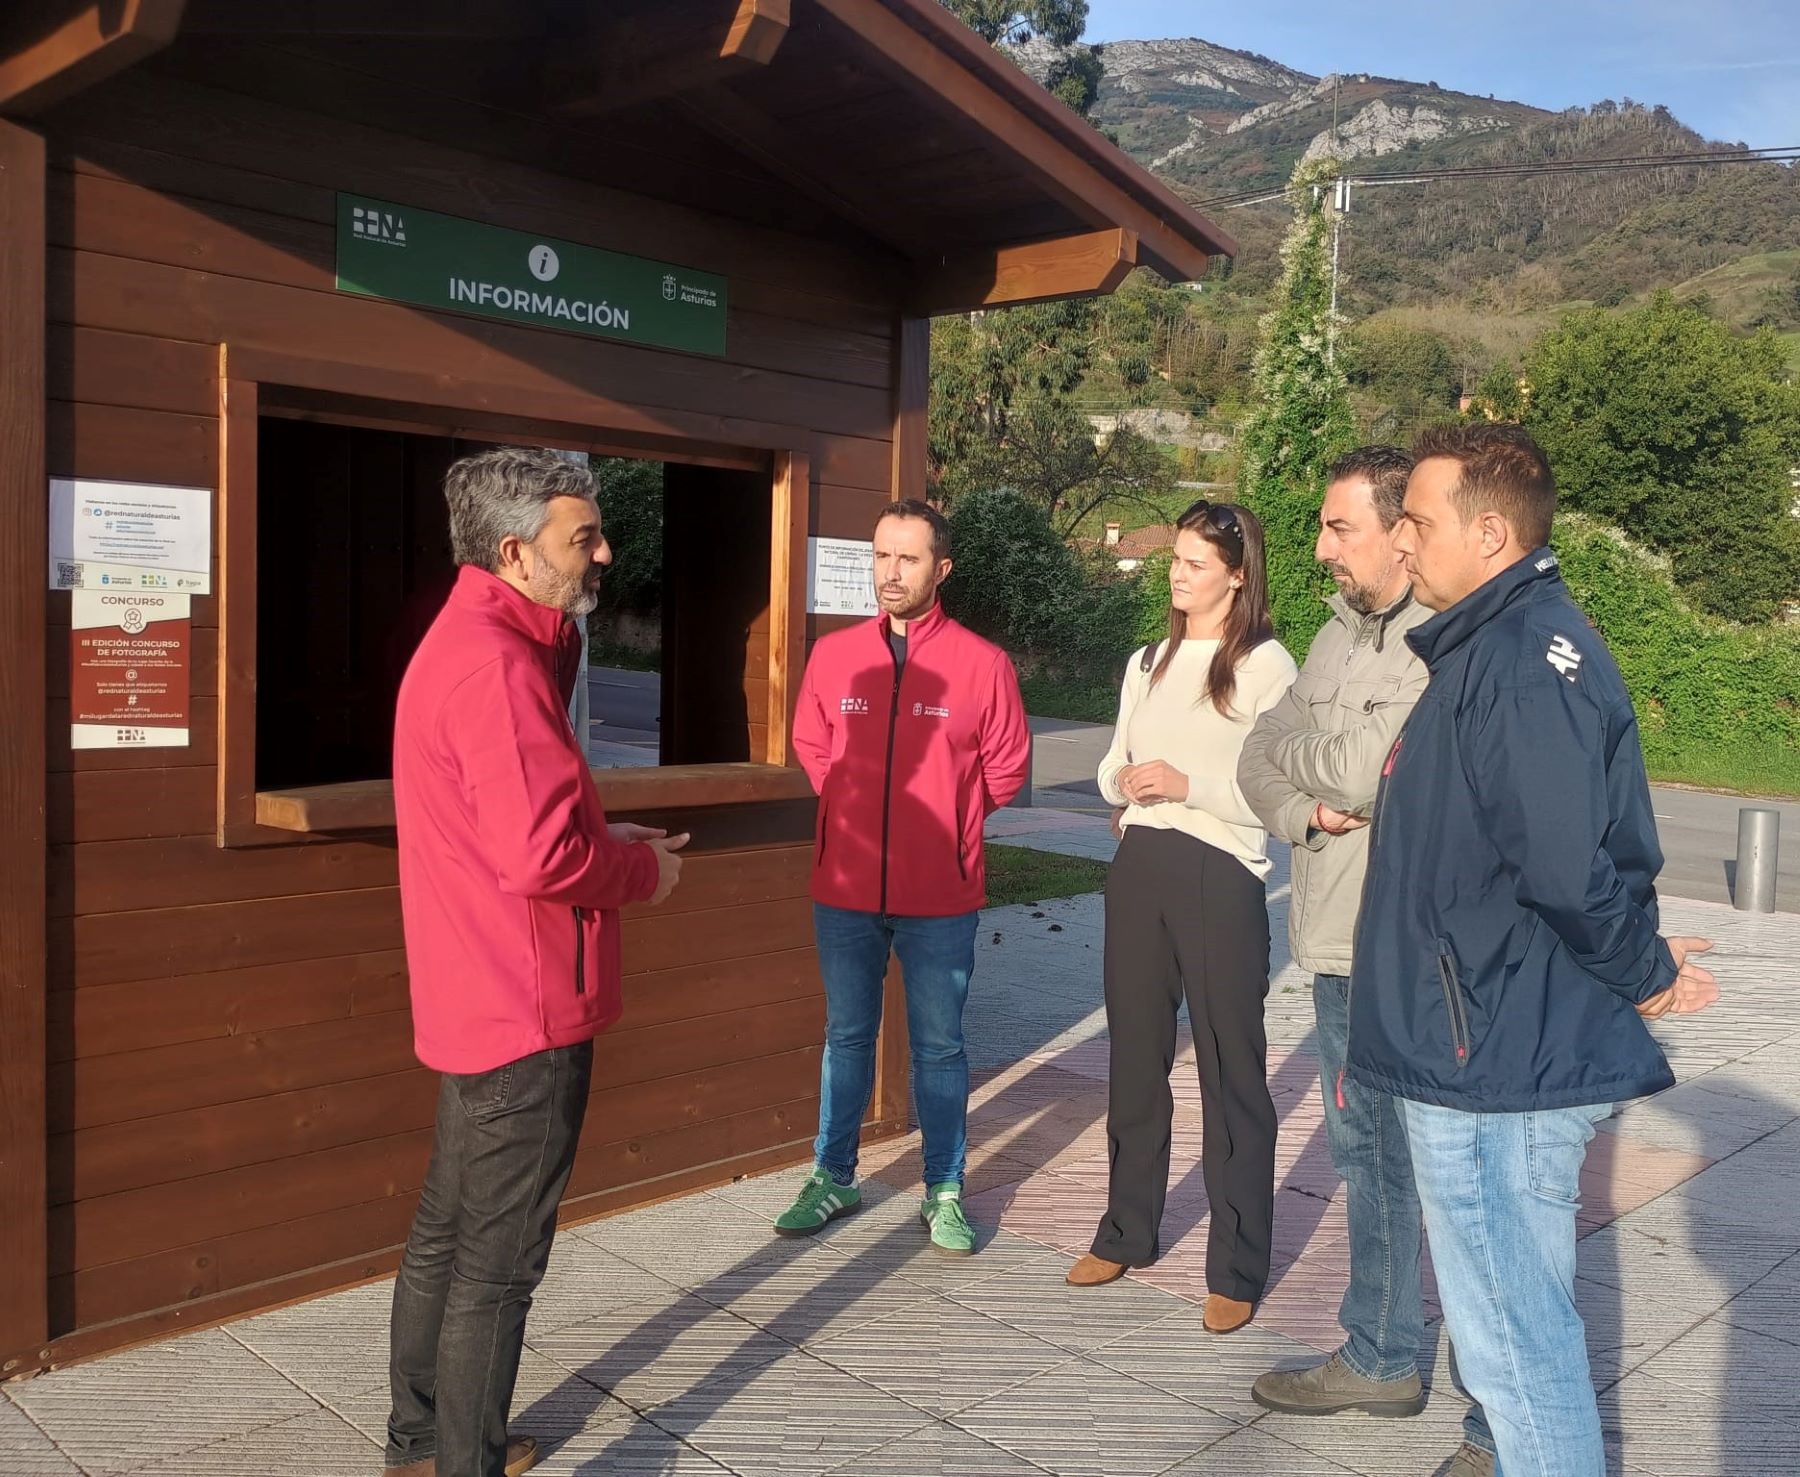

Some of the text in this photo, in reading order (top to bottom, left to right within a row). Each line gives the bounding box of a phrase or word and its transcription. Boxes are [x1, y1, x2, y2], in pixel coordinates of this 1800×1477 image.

[450, 278, 630, 330] INFORMACIÓN
[681, 292, 717, 307] Asturias
[104, 510, 181, 521] @rednaturaldeasturias
[101, 596, 164, 606] CONCURSO
[81, 638, 180, 648] III EDICIÓN CONCURSO
[111, 648, 167, 657] FOTOGRAFÍA
